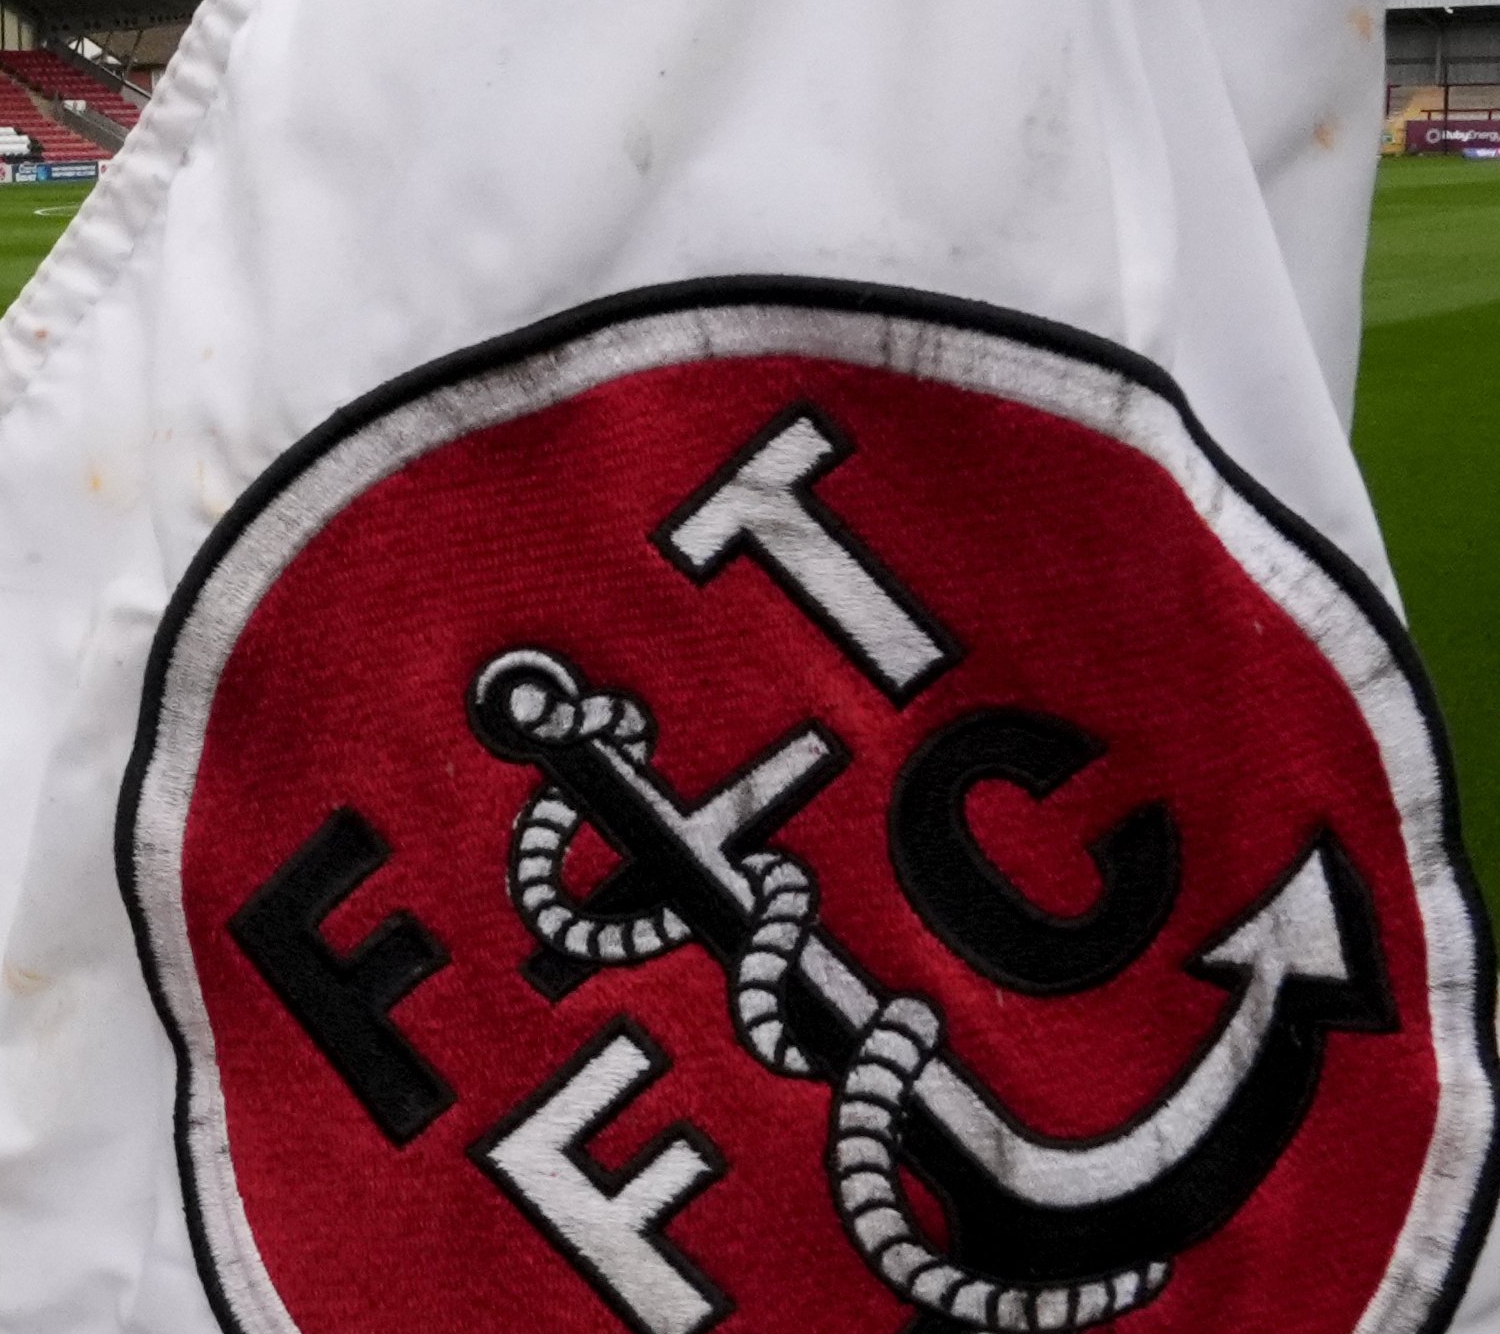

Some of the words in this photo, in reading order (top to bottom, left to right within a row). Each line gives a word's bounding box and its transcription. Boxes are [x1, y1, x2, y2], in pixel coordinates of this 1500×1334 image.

[226, 807, 456, 1148] F
[651, 400, 966, 709] T
[886, 707, 1181, 998] C
